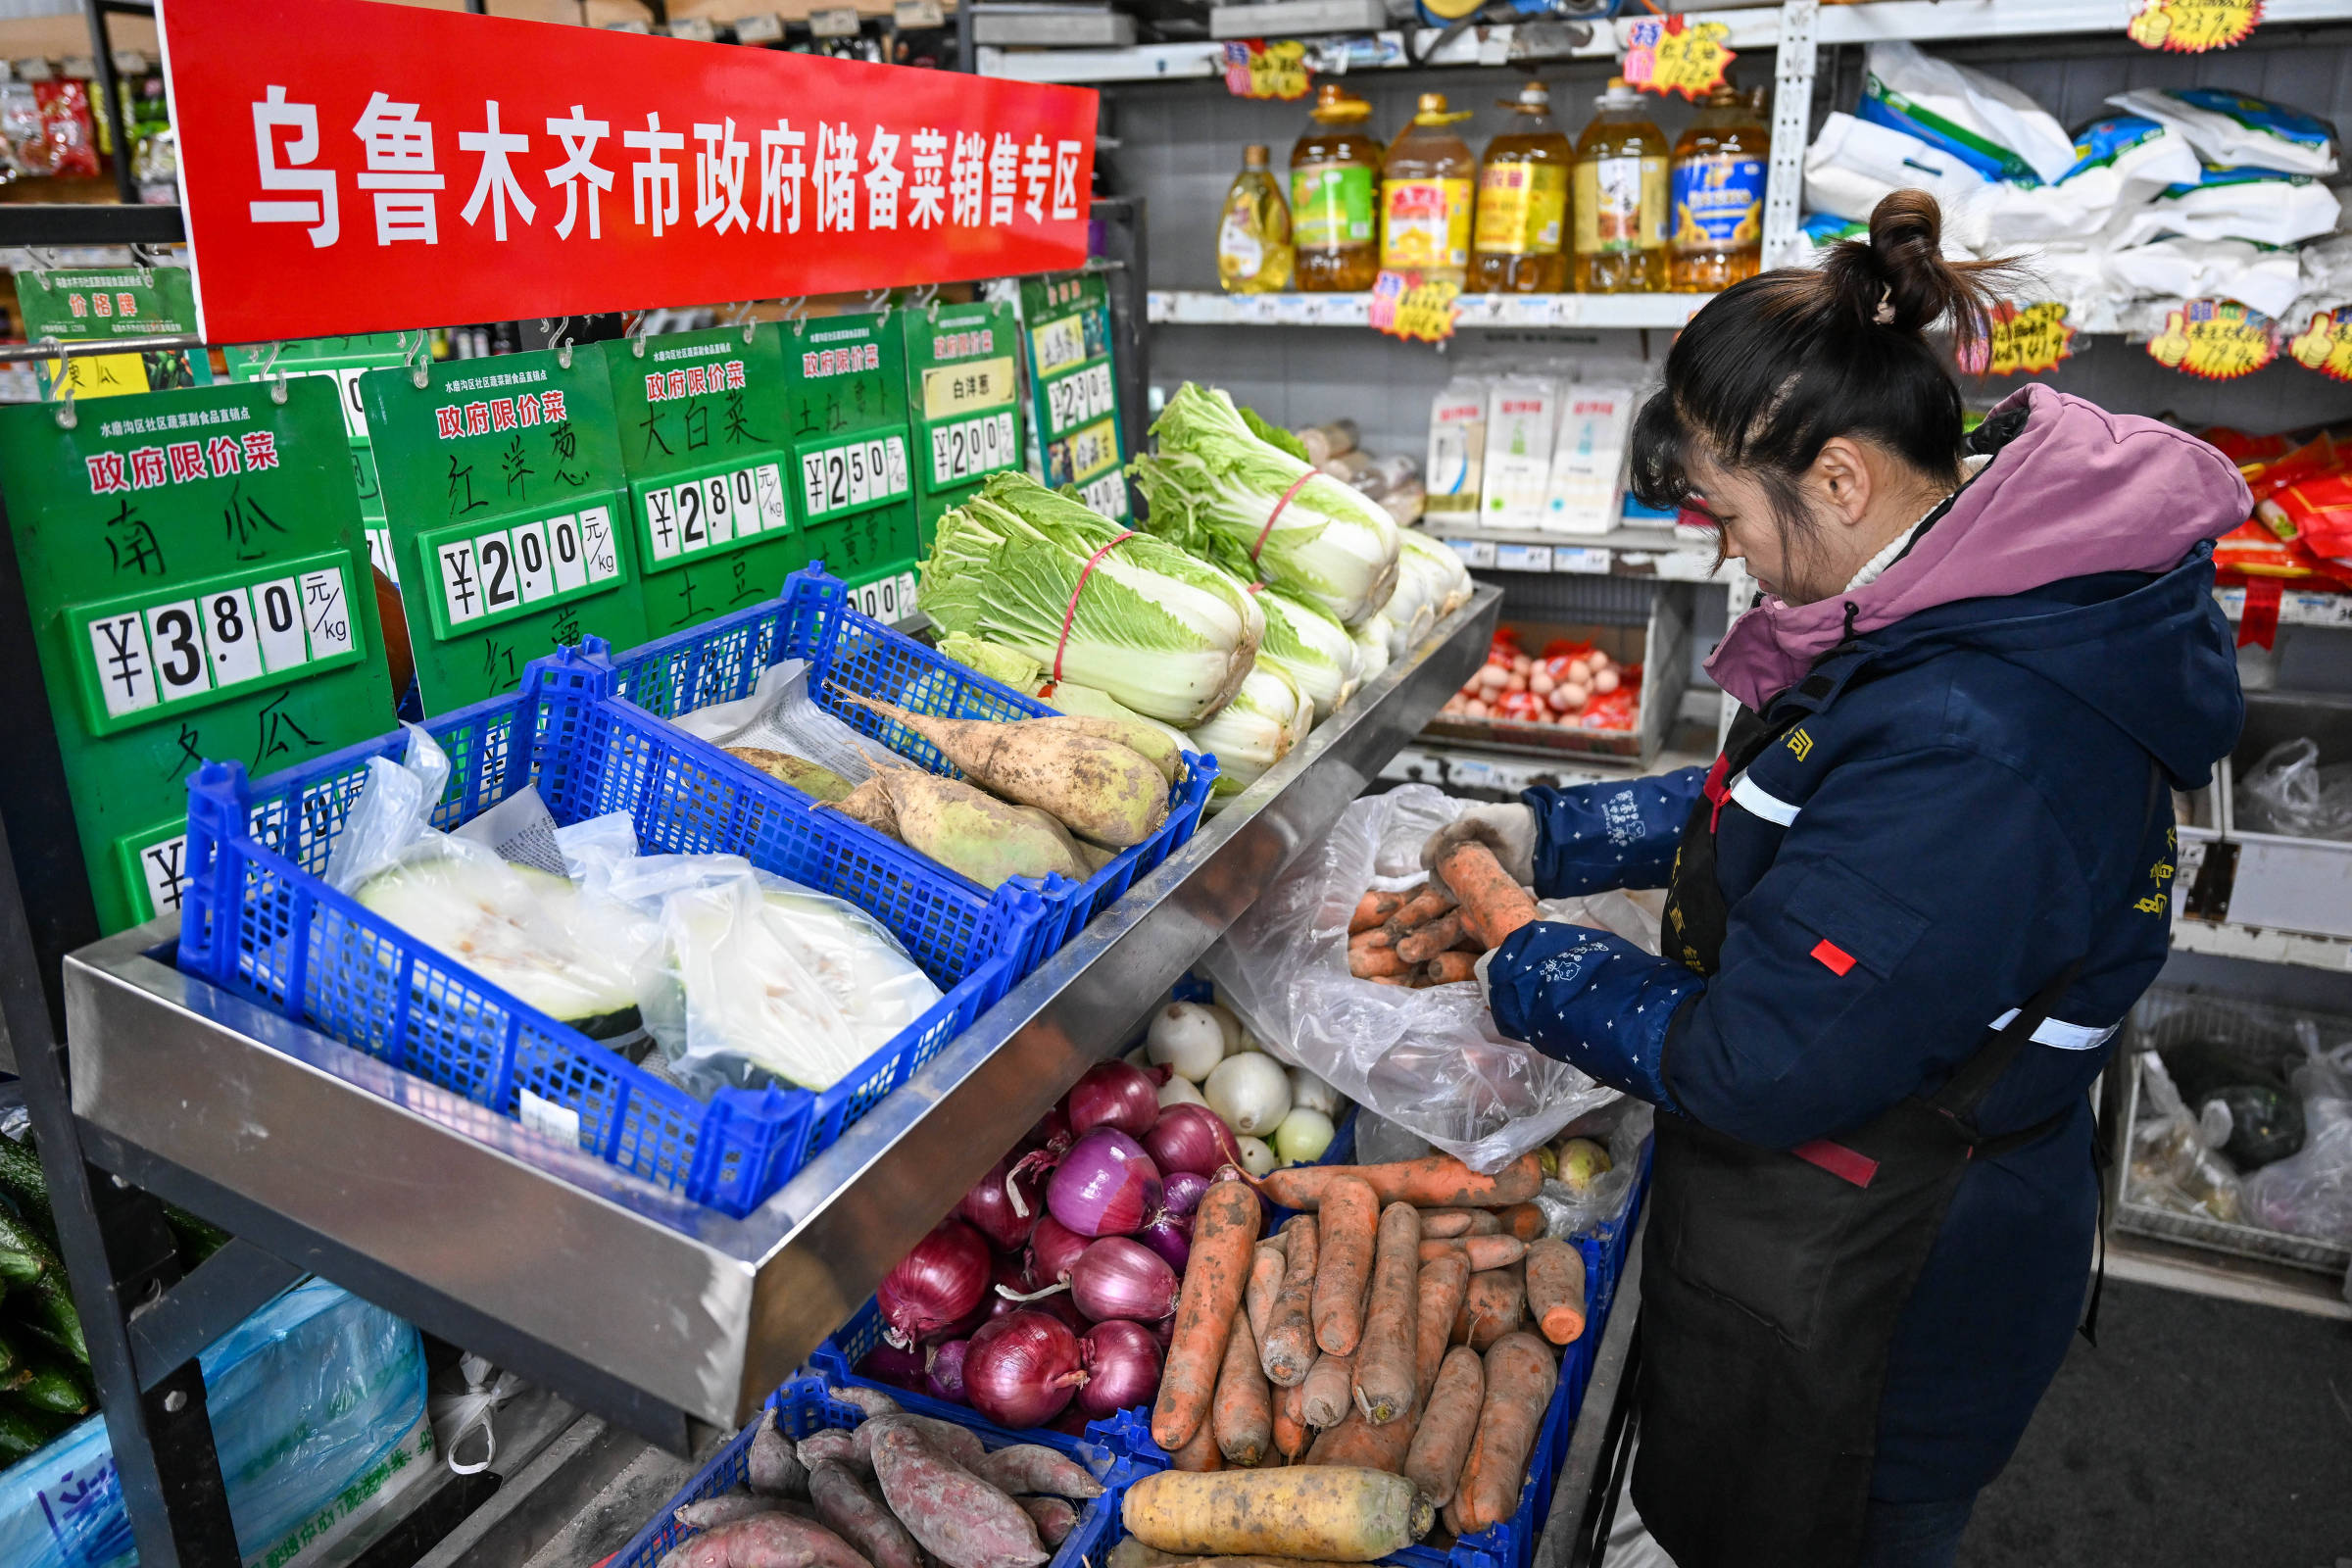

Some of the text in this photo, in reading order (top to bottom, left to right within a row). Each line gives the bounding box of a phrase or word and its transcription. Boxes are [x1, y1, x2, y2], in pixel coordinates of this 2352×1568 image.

[250, 85, 1082, 249] 乌鲁木齐市政府储备菜销售专区
[69, 292, 138, 318] 价格牌
[445, 369, 548, 394] 水磨沟区社区蔬菜副食品直销点
[646, 361, 747, 403] 政府限价菜
[803, 343, 880, 379] 政府限价菜
[100, 406, 251, 439] 水磨沟区社区蔬菜副食品直销点
[435, 389, 568, 441] 政府限价菜
[639, 390, 773, 461] 大白菜
[85, 429, 280, 496] 政府限价菜
[448, 421, 590, 519] 红洋葱
[105, 478, 291, 575] 南瓜
[669, 550, 766, 627] 土豆
